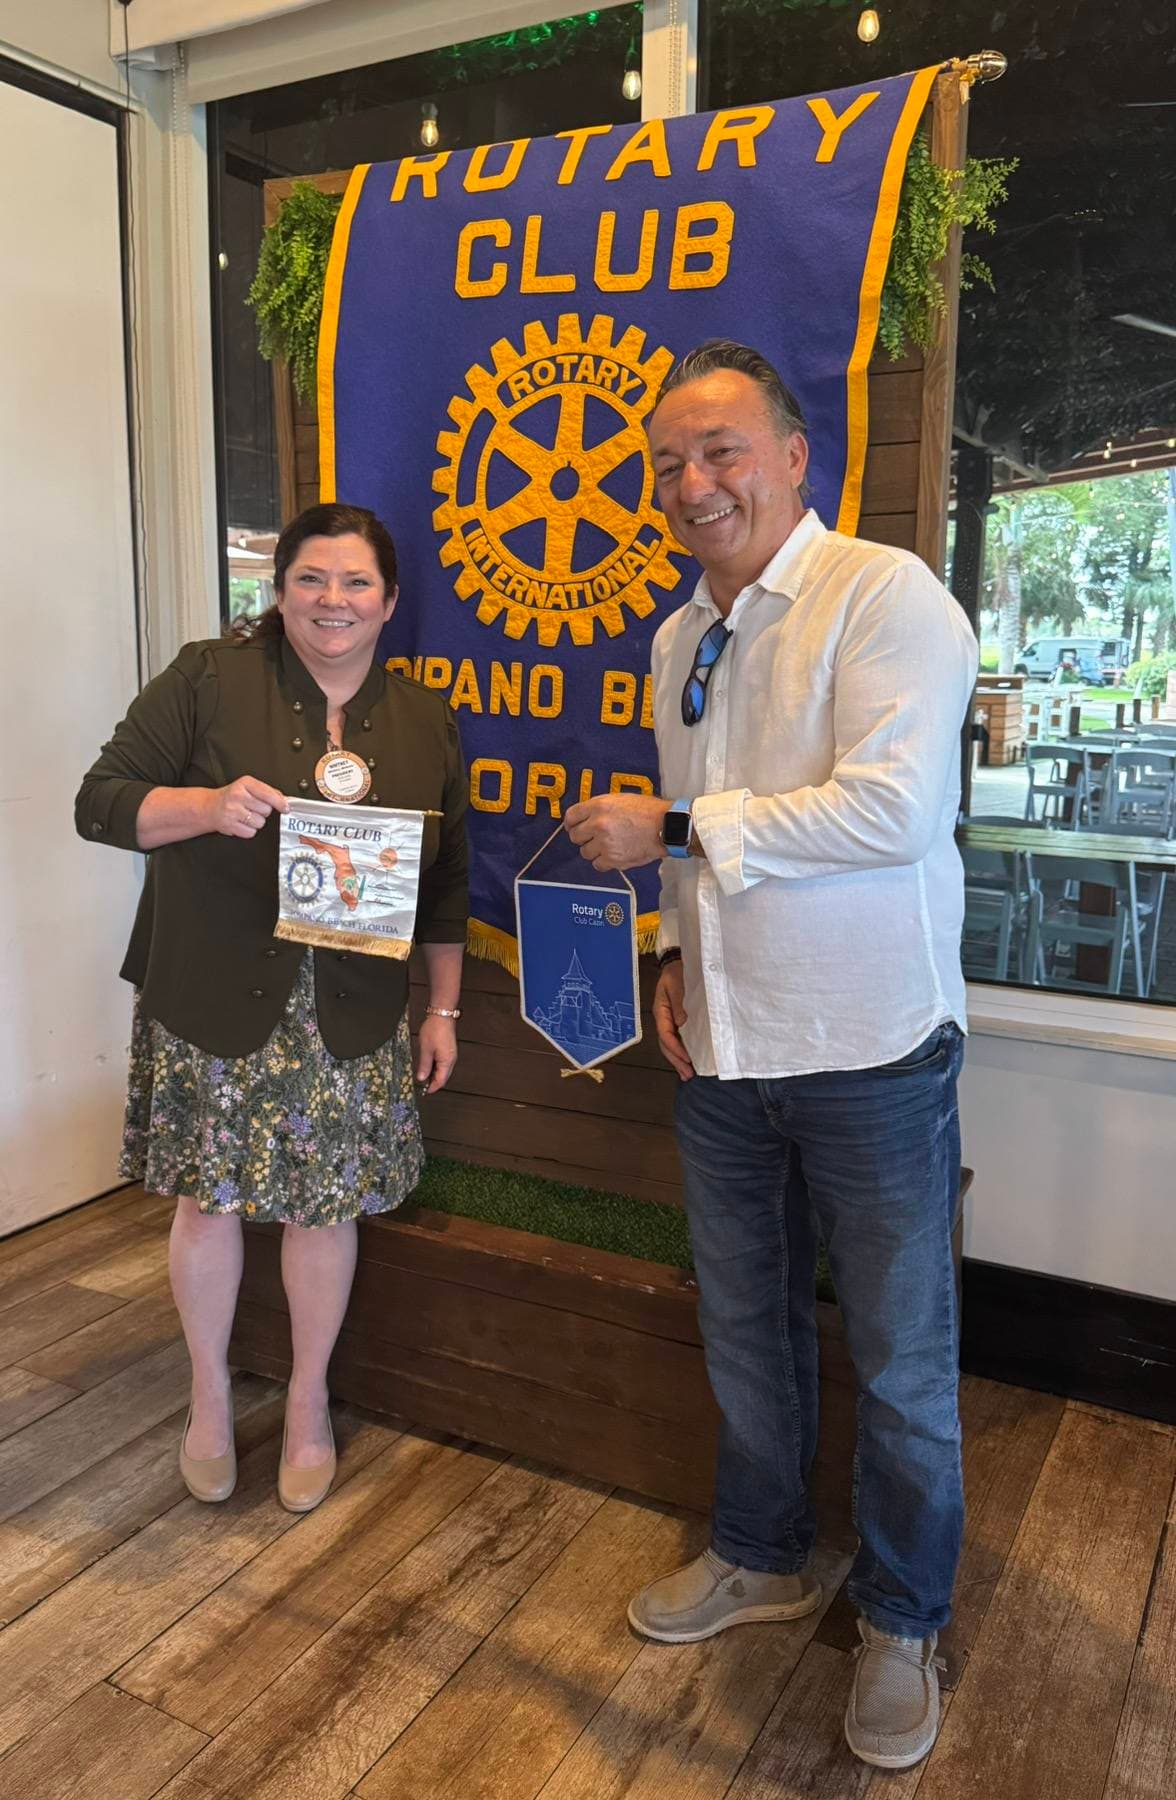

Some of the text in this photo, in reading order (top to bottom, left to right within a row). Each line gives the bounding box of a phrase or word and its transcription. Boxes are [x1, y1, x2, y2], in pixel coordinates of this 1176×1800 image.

[390, 91, 881, 202] ROTARY
[454, 201, 735, 298] CLUB
[506, 354, 643, 402] ROTARY
[464, 526, 661, 609] INTERNATIONAL
[288, 817, 382, 842] ROTARY CLUB
[358, 922, 398, 935] FLORIDA
[572, 903, 603, 919] Rotary
[574, 916, 588, 925] Club
